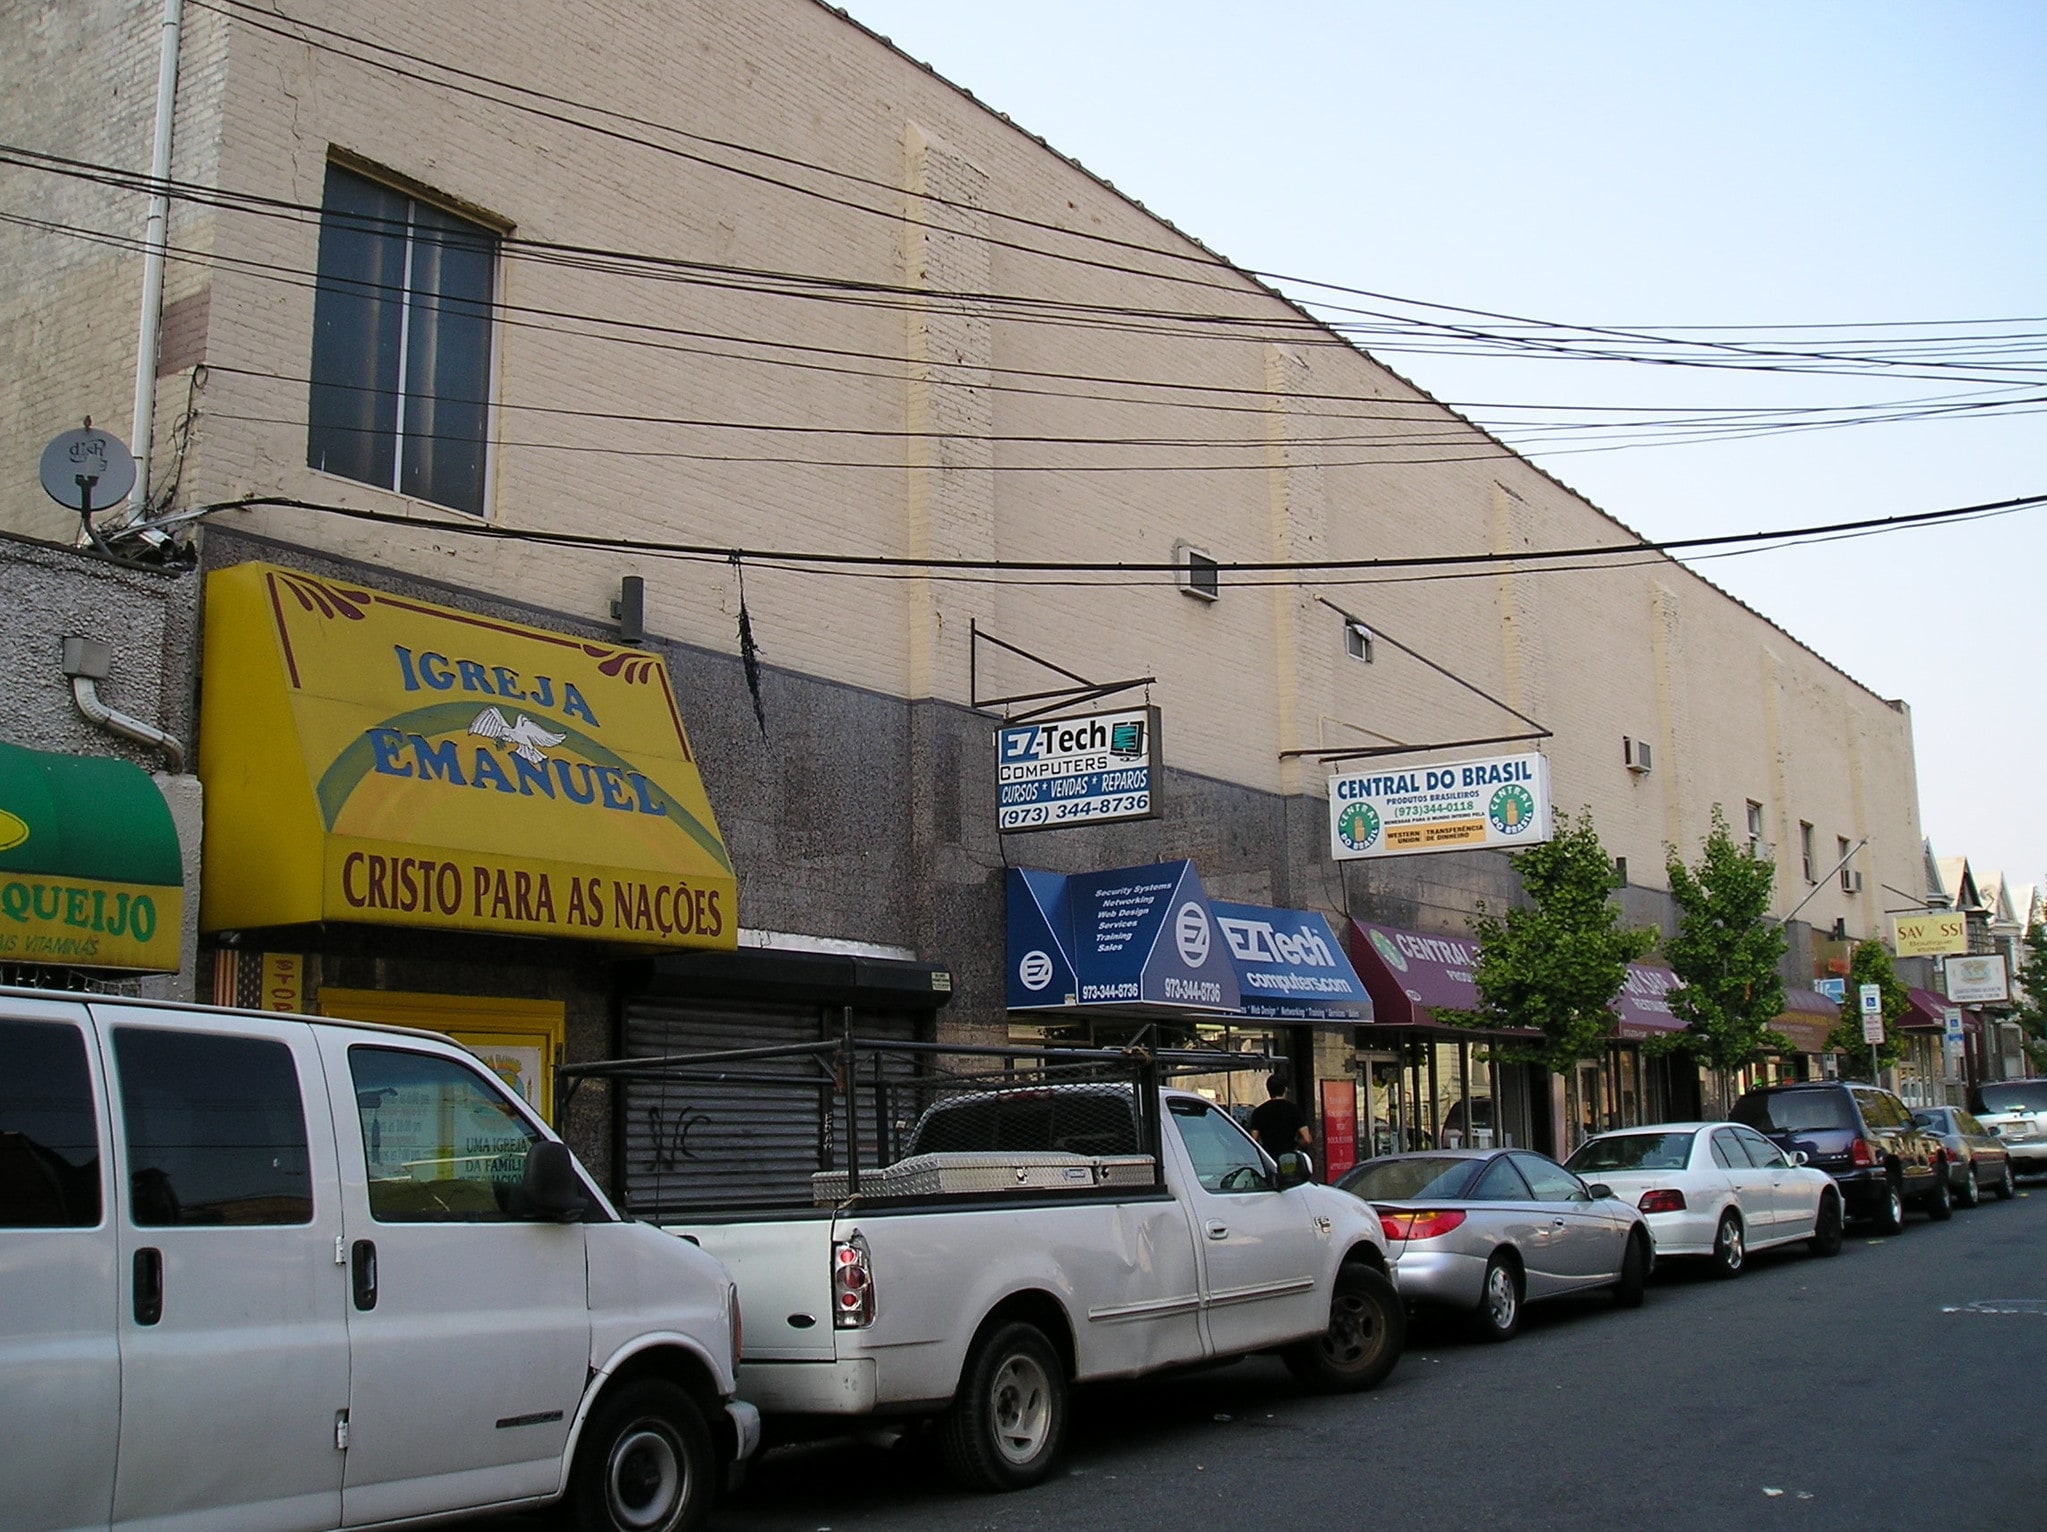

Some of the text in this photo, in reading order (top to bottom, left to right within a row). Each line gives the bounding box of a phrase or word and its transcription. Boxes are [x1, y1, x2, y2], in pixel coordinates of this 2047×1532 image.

[394, 644, 599, 727] IGREJA
[365, 727, 666, 816] EMANUEL
[1337, 761, 1532, 800] CENTRAL DO BRASIL
[1002, 769, 1148, 804] CURSOS VENDAS REPAROS
[1386, 790, 1480, 805] PRODUTOS BRASILEIROS
[1490, 785, 1533, 810] CENTRAL
[1001, 794, 1149, 828] (973) 344-8736
[1340, 802, 1379, 827] CENTRAL
[1394, 801, 1474, 818] (973)344-0118
[1504, 810, 1533, 835] BRASIL
[1387, 830, 1420, 839] WESTERN
[342, 851, 723, 939] CRISTO PARA AS NAÇÕES
[1095, 882, 1173, 898] Security Systems
[1102, 895, 1155, 907] Networking
[1, 882, 156, 942] QUEIJO
[1098, 907, 1149, 919] Web Design
[1098, 919, 1138, 930] Services
[1096, 931, 1132, 942] Training
[1097, 943, 1123, 953] Sales
[1395, 933, 1477, 967] CENTRAL
[1082, 983, 1139, 1000] 973-344-8736
[1164, 977, 1221, 1003] 973-344-8736
[1246, 971, 1352, 994] computers.com
[466, 1137, 528, 1154] UMA IGREJA
[465, 1159, 481, 1172] DA
